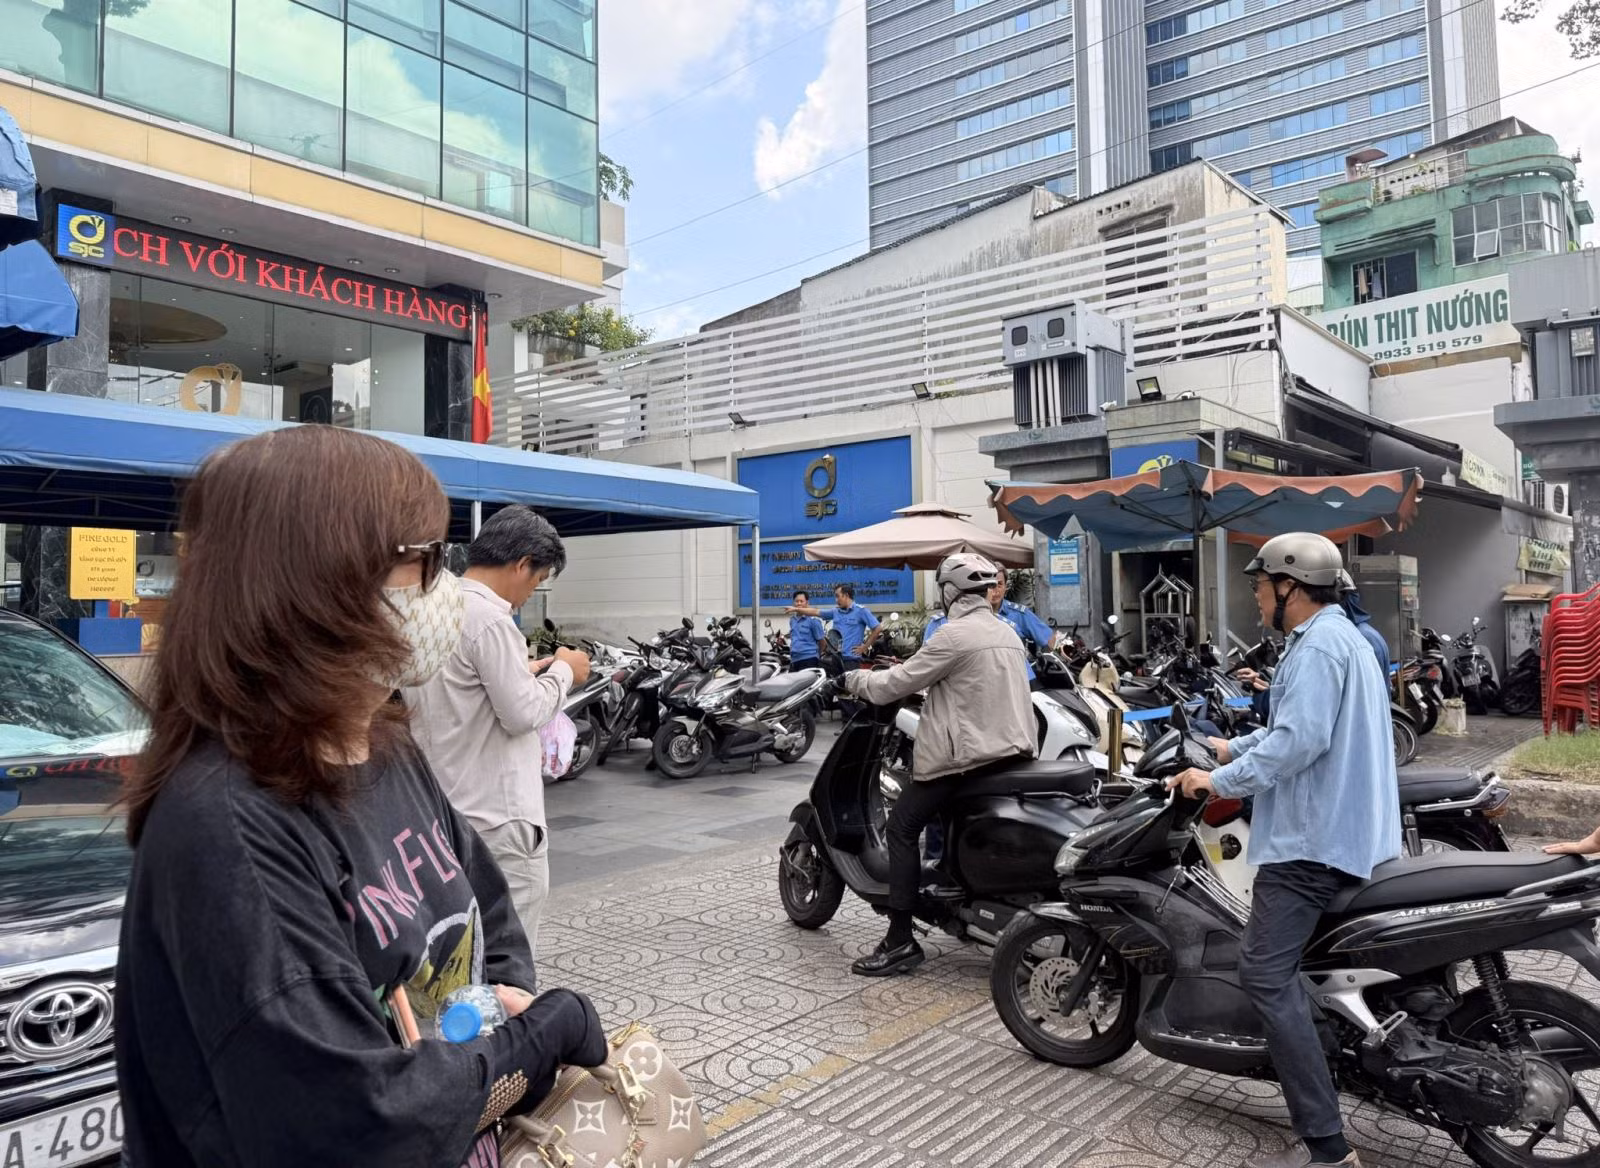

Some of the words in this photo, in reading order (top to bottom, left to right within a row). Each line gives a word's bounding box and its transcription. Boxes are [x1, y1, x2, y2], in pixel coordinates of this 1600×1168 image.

[113, 227, 170, 266] CH
[178, 243, 247, 283] VỚI
[255, 258, 376, 310] KHÁCH
[383, 287, 469, 329] HÀNG
[1374, 306, 1419, 345] THỊT
[1426, 288, 1509, 335] NƯỚNG
[1416, 340, 1447, 354] 519
[1451, 334, 1483, 348] 579
[103, 535, 128, 543] GOLD
[1080, 904, 1114, 913] HONDA
